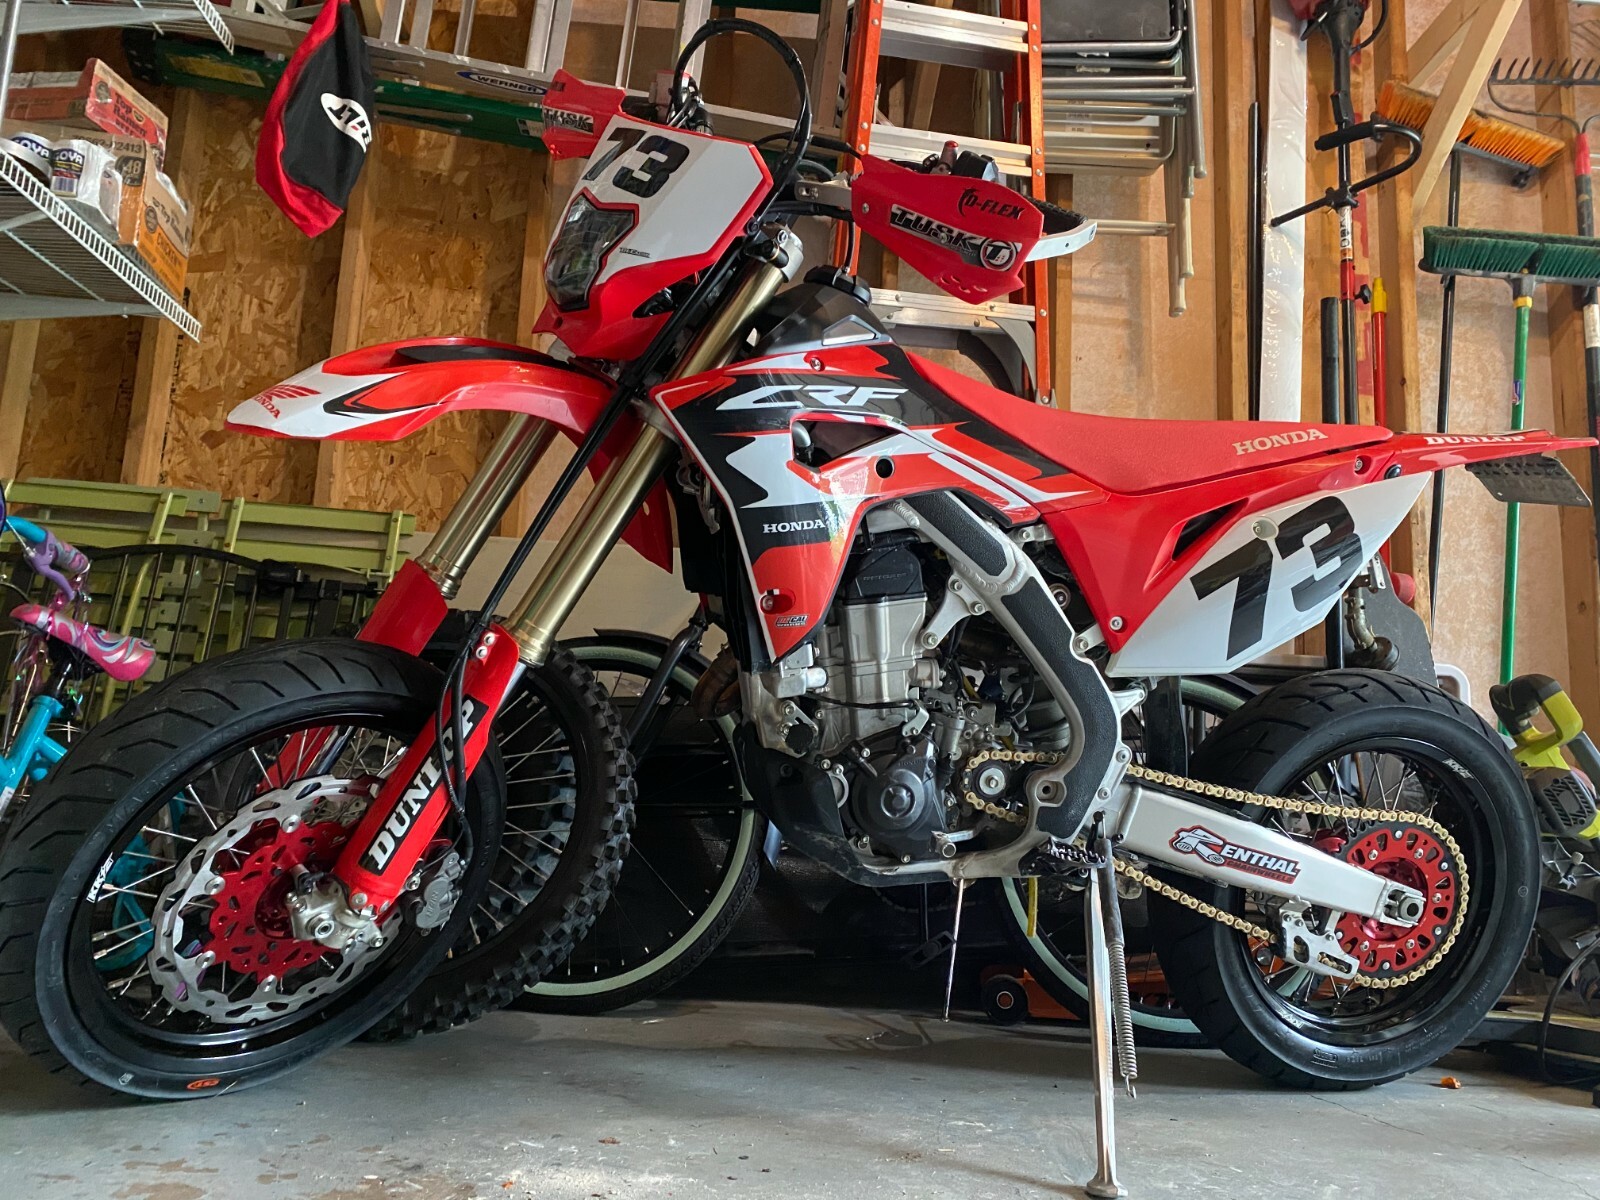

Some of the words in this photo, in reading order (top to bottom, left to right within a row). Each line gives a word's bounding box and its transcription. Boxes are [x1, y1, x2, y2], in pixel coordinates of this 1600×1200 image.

[477, 75, 539, 93] WERNER
[114, 92, 133, 115] Top
[544, 107, 592, 130] TUSK
[581, 127, 690, 198] 73
[962, 189, 1025, 220] D-FLEX
[894, 206, 981, 252] TUSK
[253, 395, 281, 419] ONDA
[715, 384, 910, 411] CRF
[1231, 427, 1329, 456] HONDA
[1423, 435, 1526, 445] DUNLOP
[762, 518, 827, 535] HONDA
[1190, 495, 1363, 661] 73
[1173, 827, 1300, 876] RENTHAL
[1226, 860, 1296, 883] CHAINWHEELS
